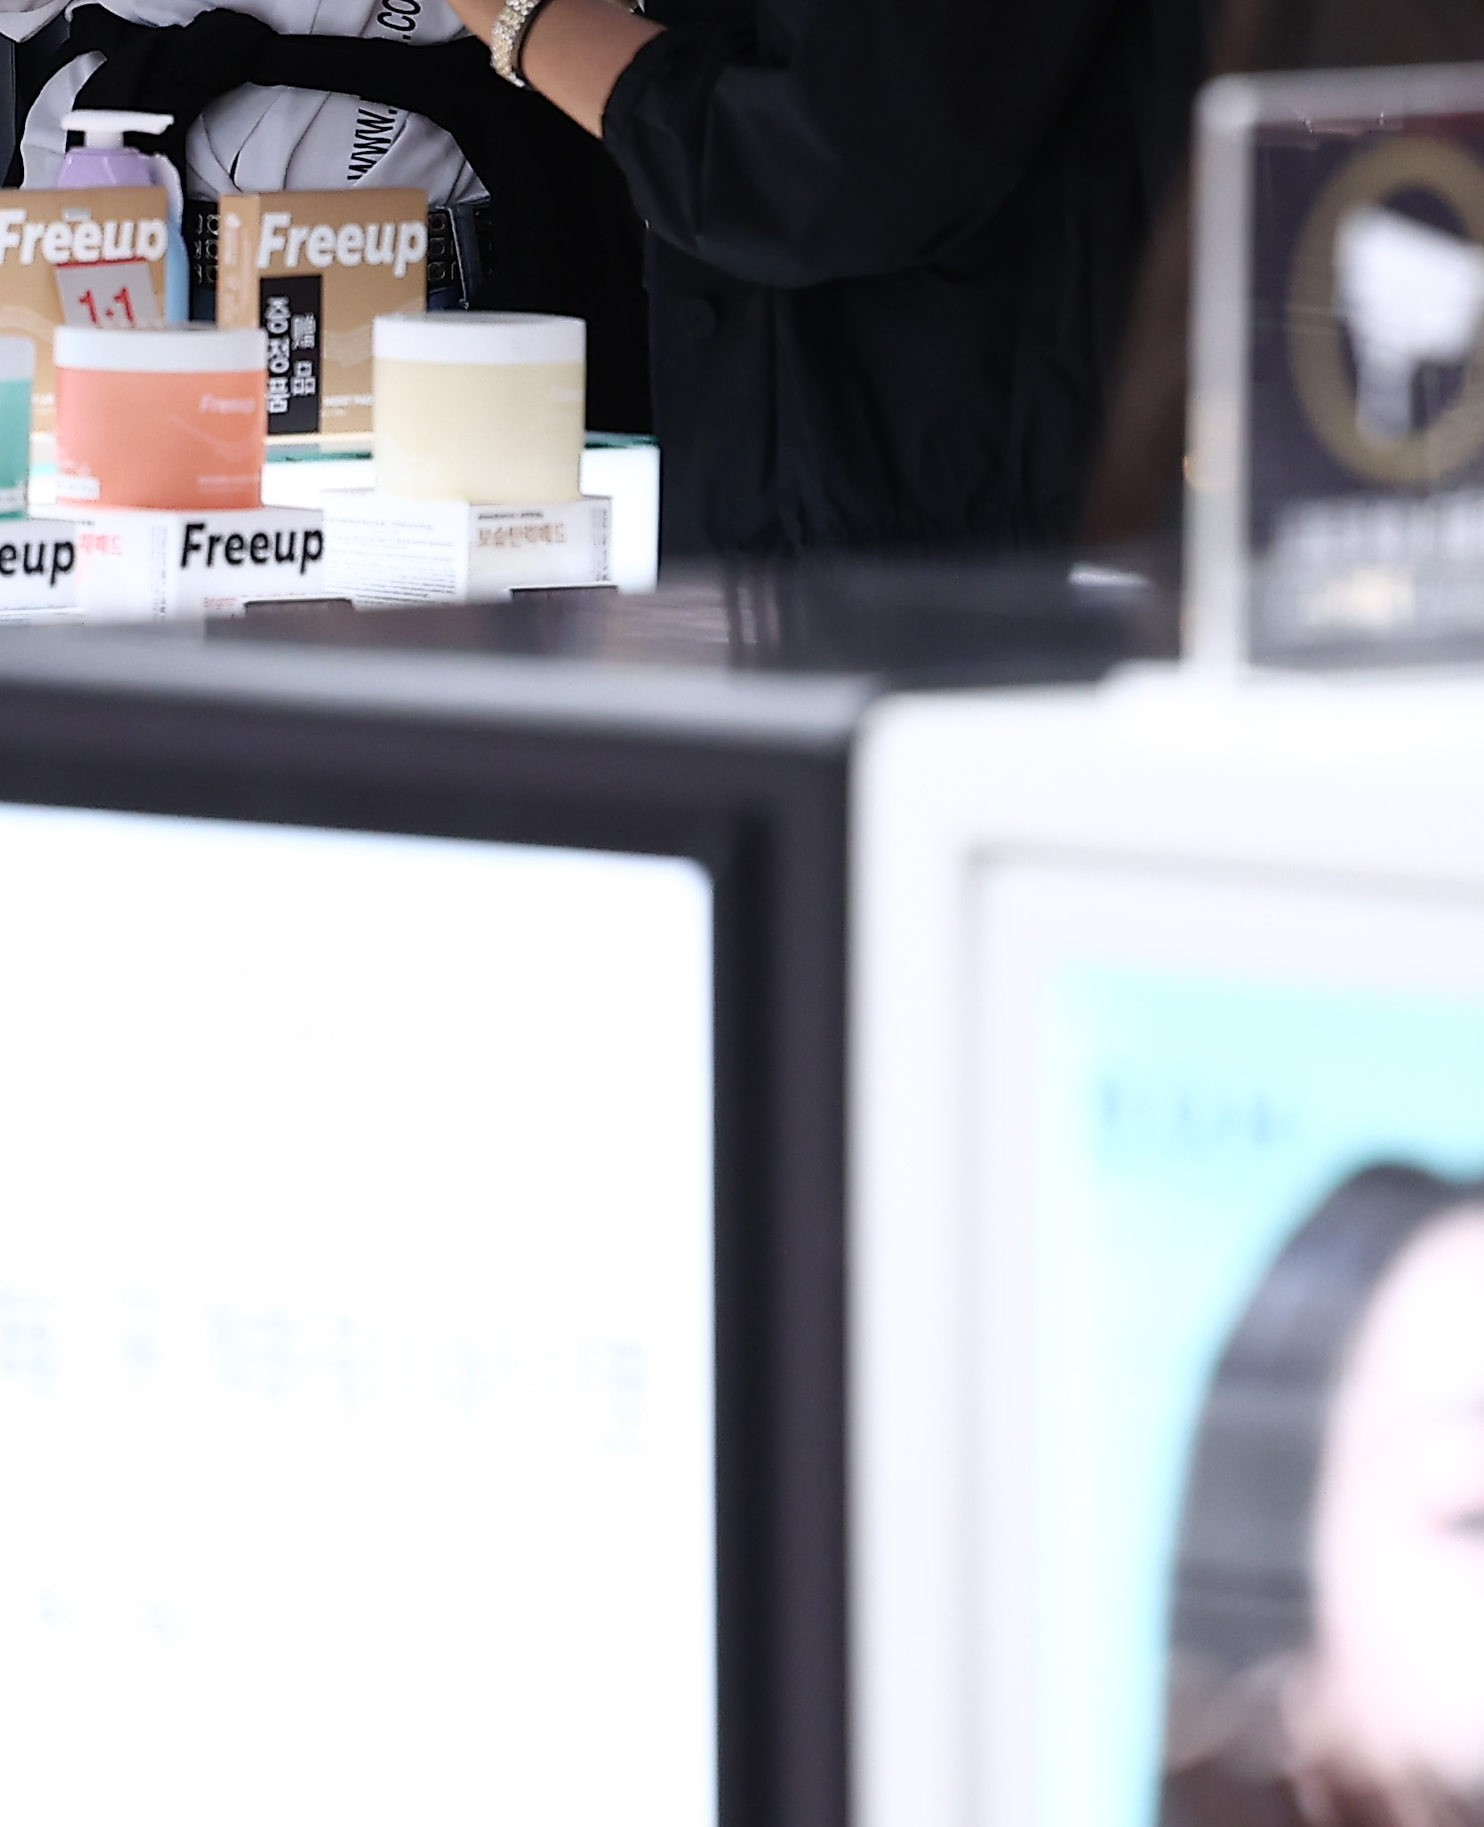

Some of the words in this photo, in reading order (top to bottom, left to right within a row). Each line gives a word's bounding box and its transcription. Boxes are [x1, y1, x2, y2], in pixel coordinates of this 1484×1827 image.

[256, 211, 428, 276] Freeup
[264, 295, 292, 414] 증정품
[180, 520, 325, 575] Freeup
